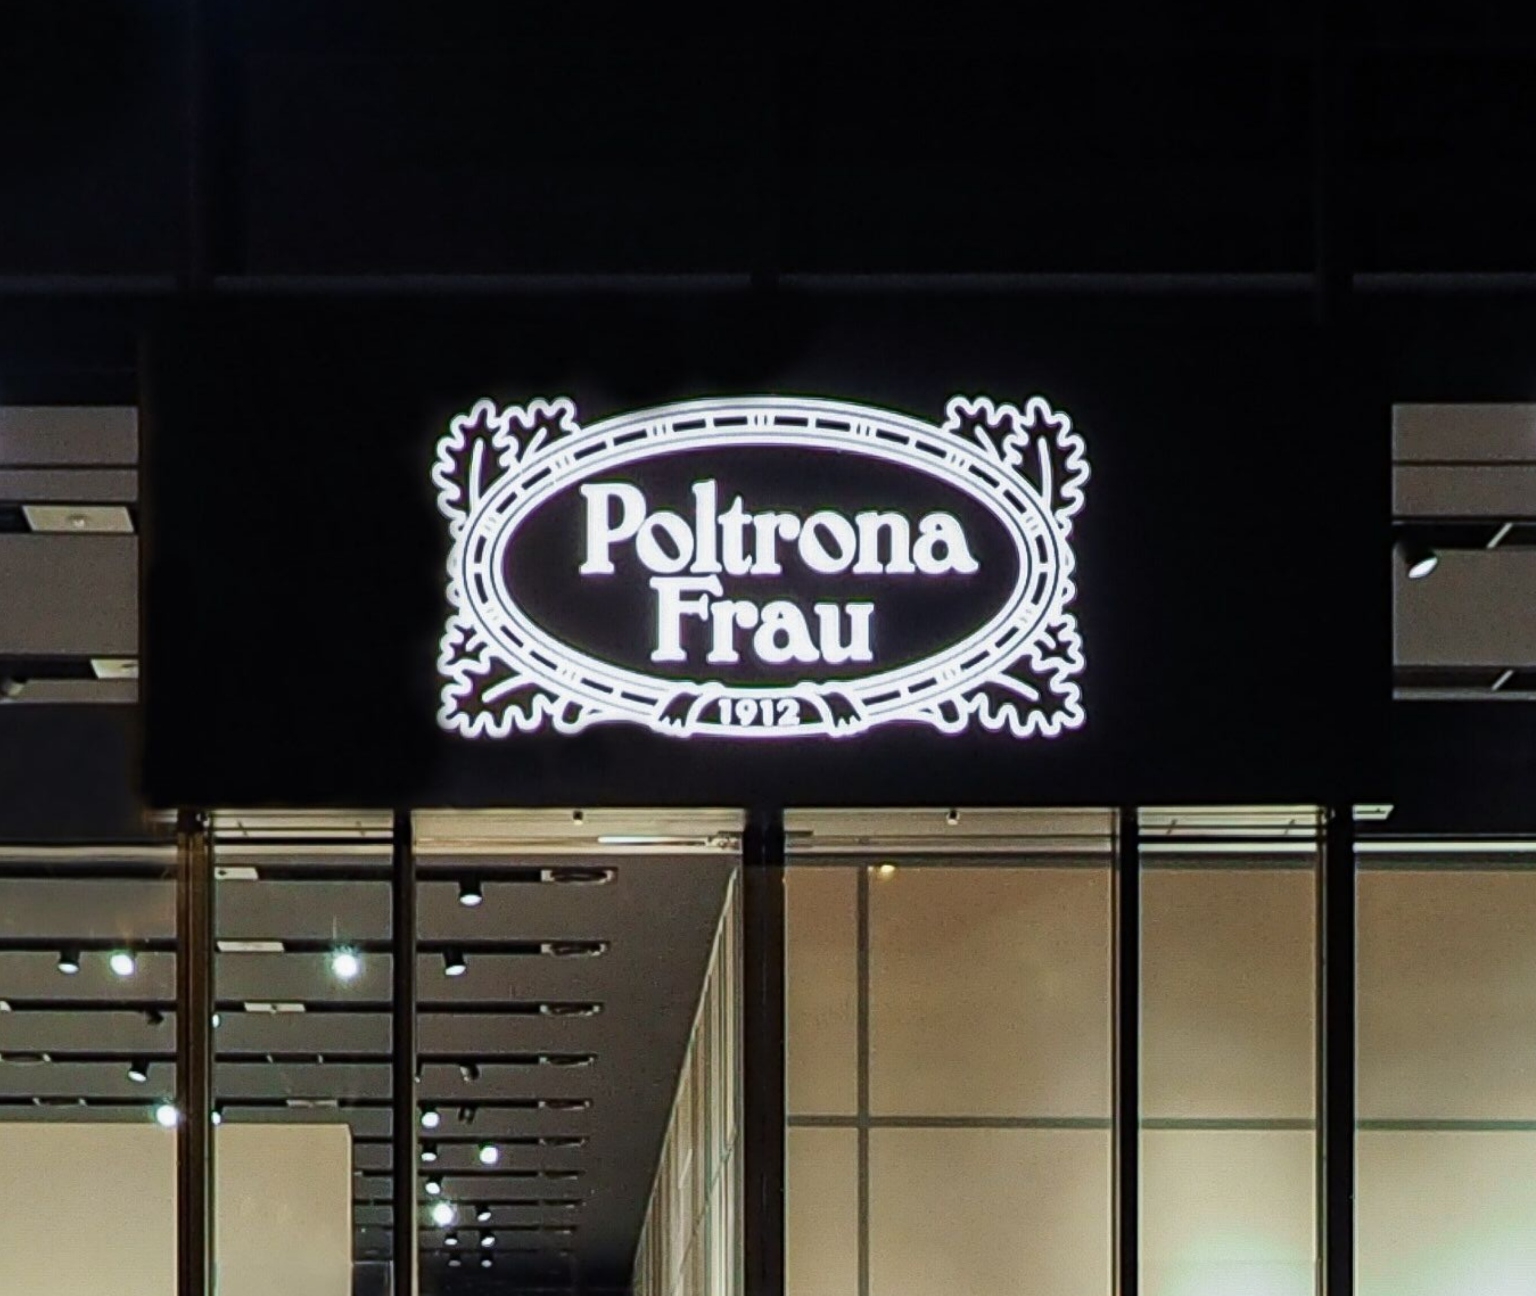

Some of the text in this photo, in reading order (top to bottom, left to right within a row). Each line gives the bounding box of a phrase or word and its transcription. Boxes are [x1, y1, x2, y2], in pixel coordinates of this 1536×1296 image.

[579, 479, 979, 575] Poltrona
[649, 573, 875, 664] Frau
[718, 698, 800, 726] 1912
